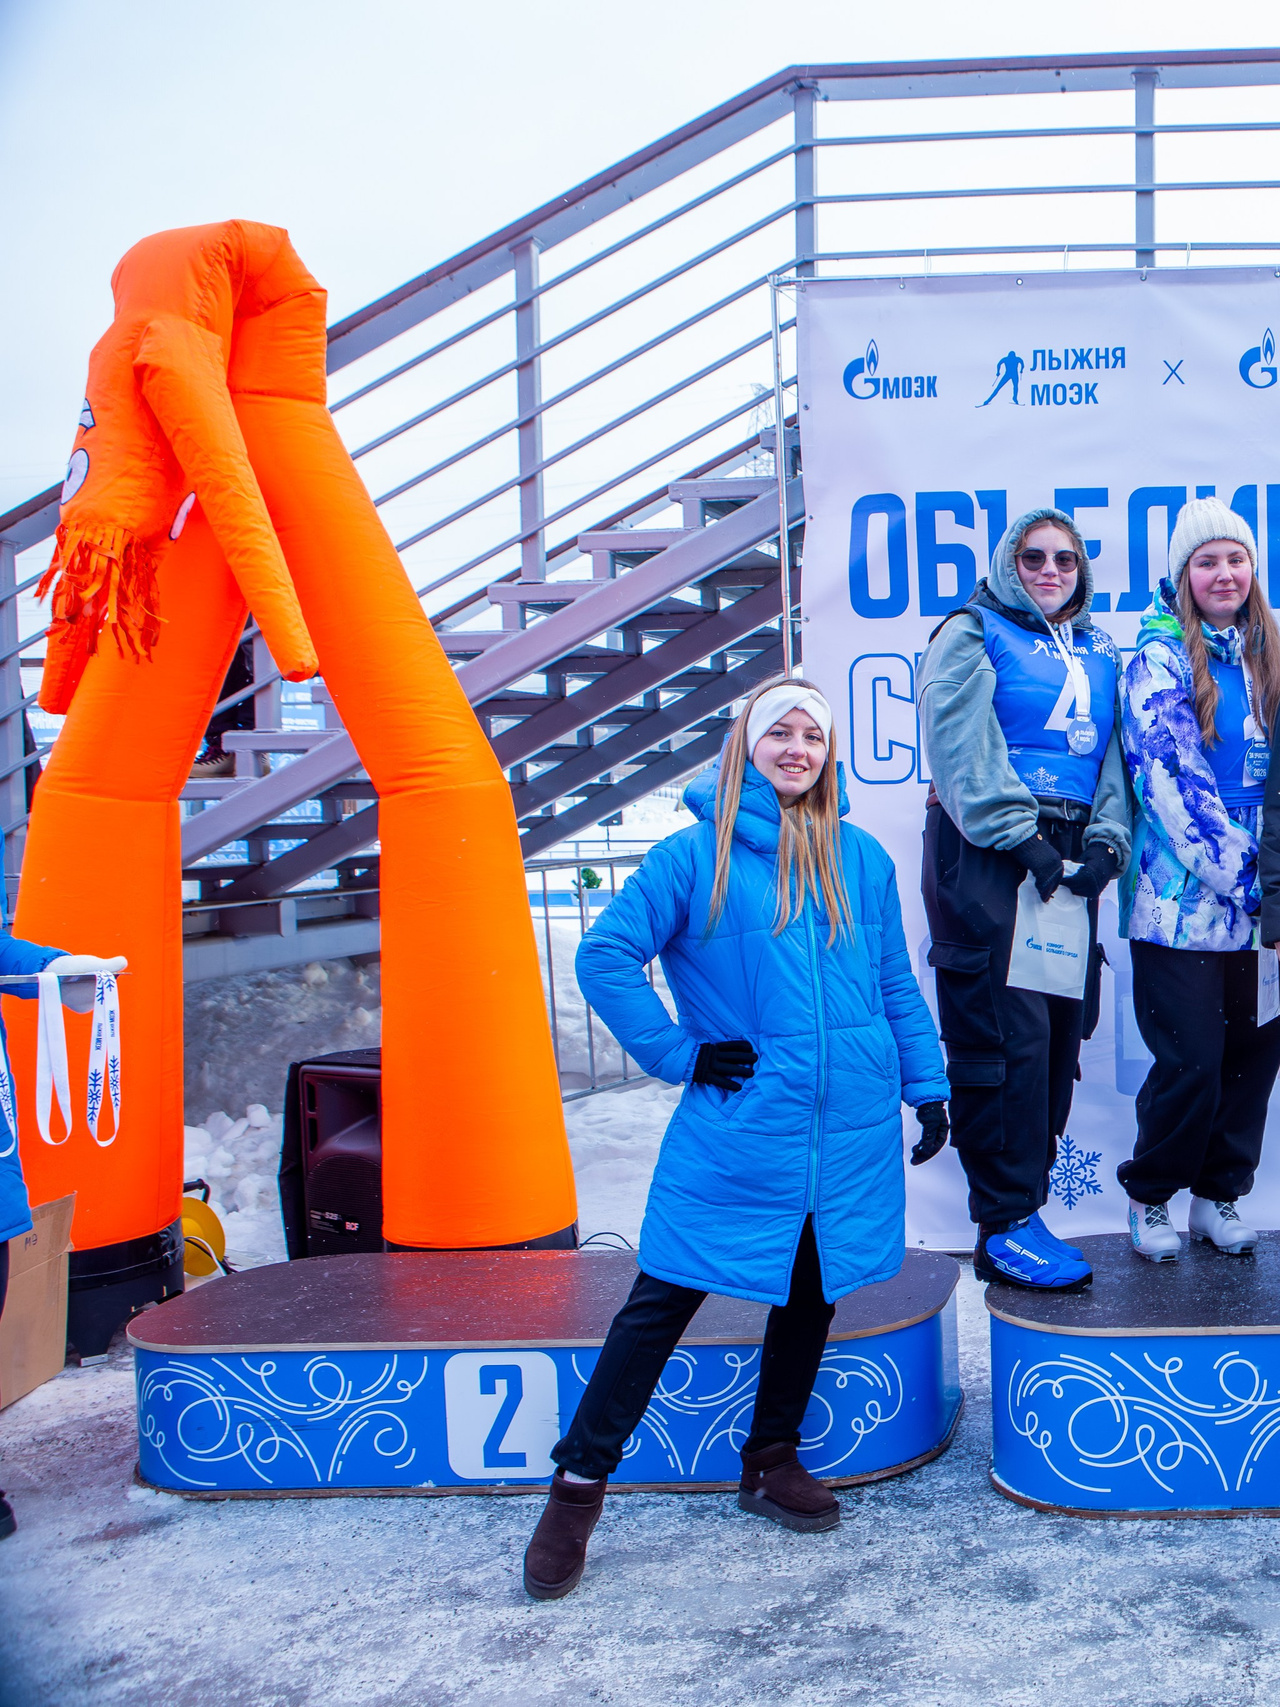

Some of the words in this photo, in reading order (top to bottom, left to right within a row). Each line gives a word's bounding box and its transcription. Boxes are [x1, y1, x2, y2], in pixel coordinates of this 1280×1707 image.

[1029, 345, 1127, 372] ЛЫЖНЯ
[882, 374, 938, 400] МОЭК
[1030, 381, 1100, 407] МОЭК
[1047, 640, 1089, 656] ЛНЯ
[478, 1364, 528, 1469] 2
